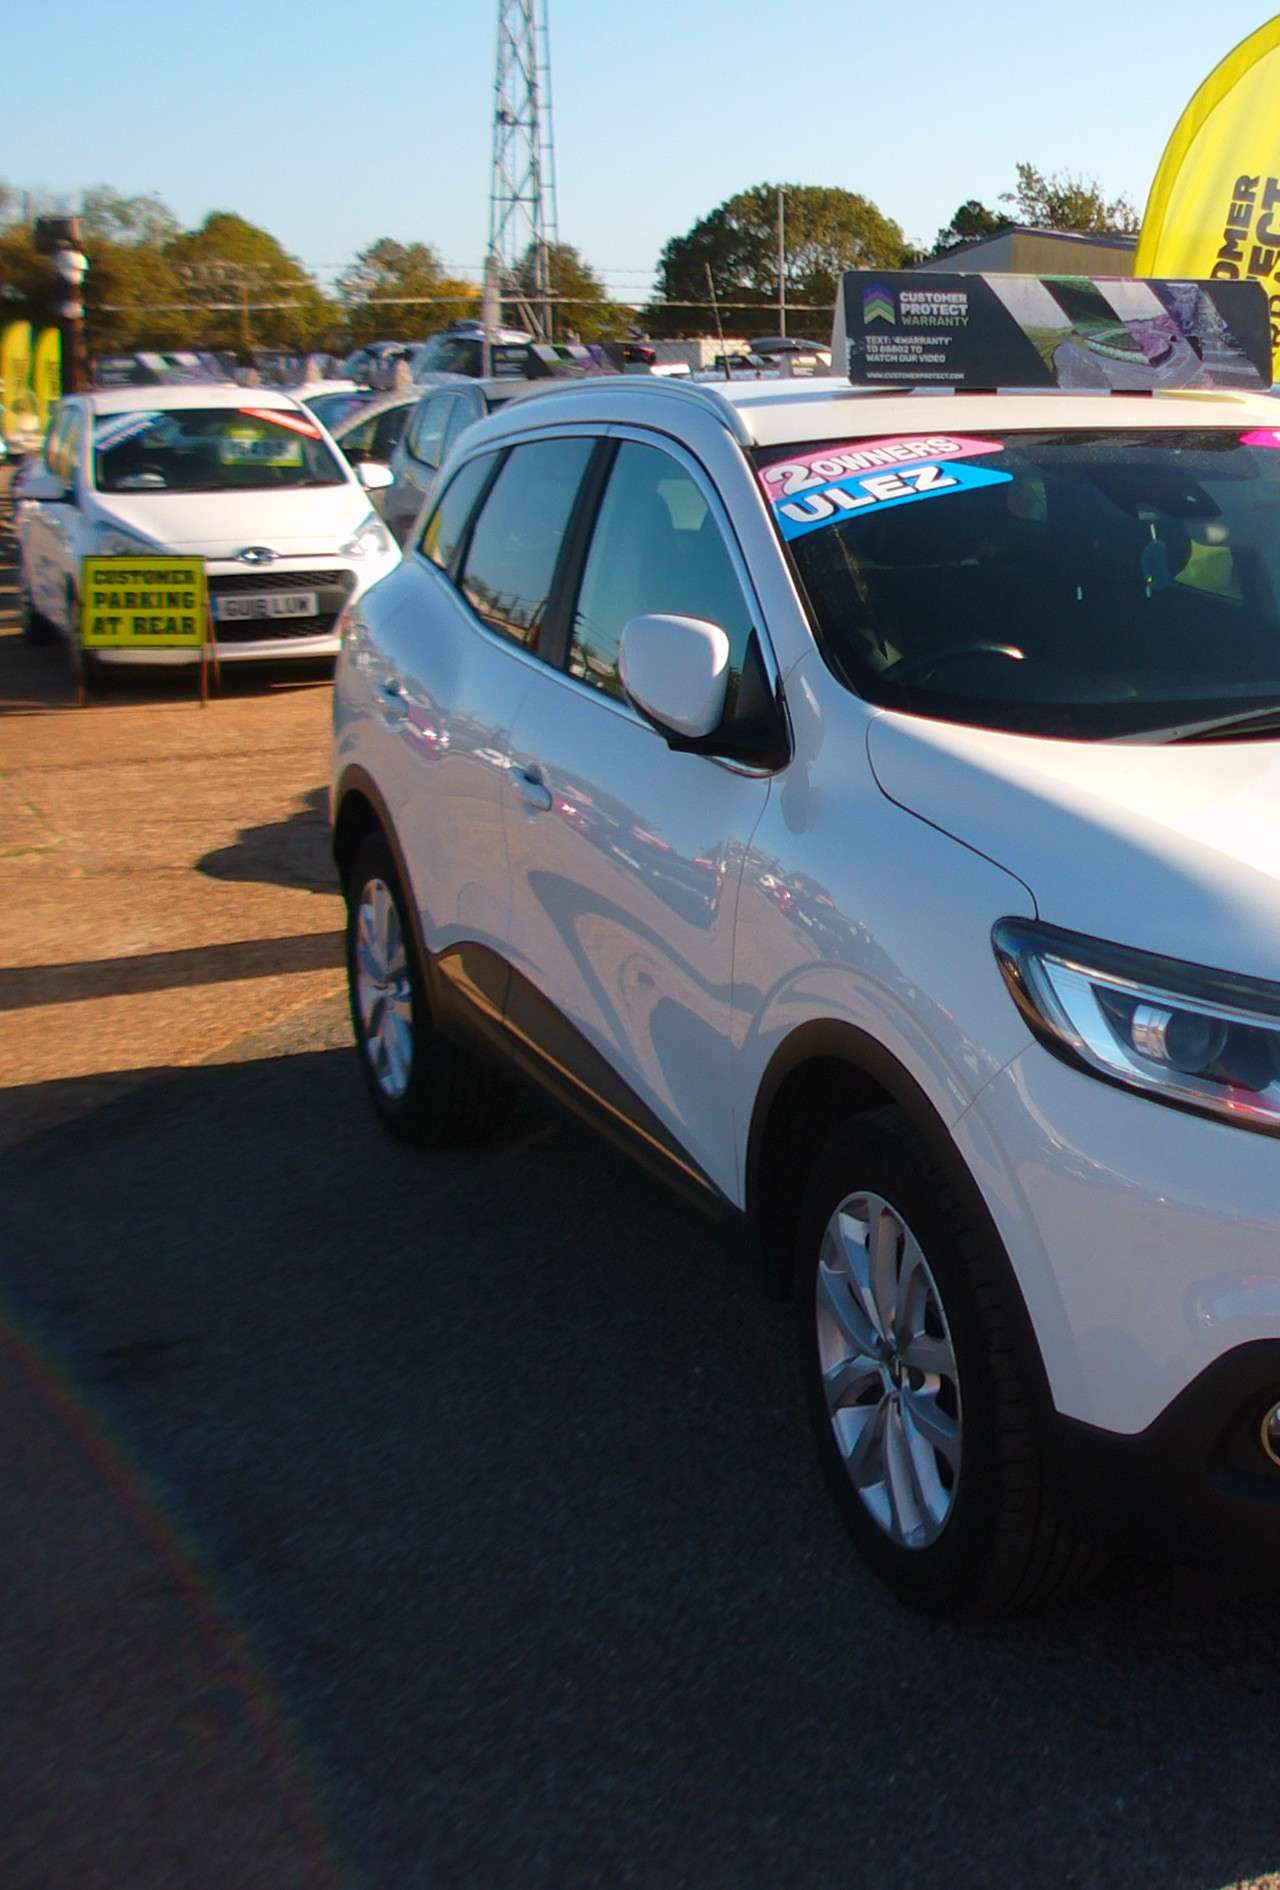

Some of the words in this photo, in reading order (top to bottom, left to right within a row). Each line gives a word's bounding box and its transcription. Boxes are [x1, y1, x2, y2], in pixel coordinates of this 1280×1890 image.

[899, 291, 968, 304] CUSTOMER
[900, 303, 969, 316] PROTECT
[900, 315, 969, 327] WARRANTY
[866, 345, 878, 353] TO
[911, 345, 923, 354] TO
[866, 354, 898, 363] WATCH
[899, 354, 918, 363] OUR
[919, 355, 946, 364] VIDEO
[780, 464, 958, 523] ULEZ
[93, 570, 196, 586] CUSTOMER
[93, 591, 196, 610] PARKING
[93, 616, 121, 635] AT
[133, 616, 196, 635] REAR
